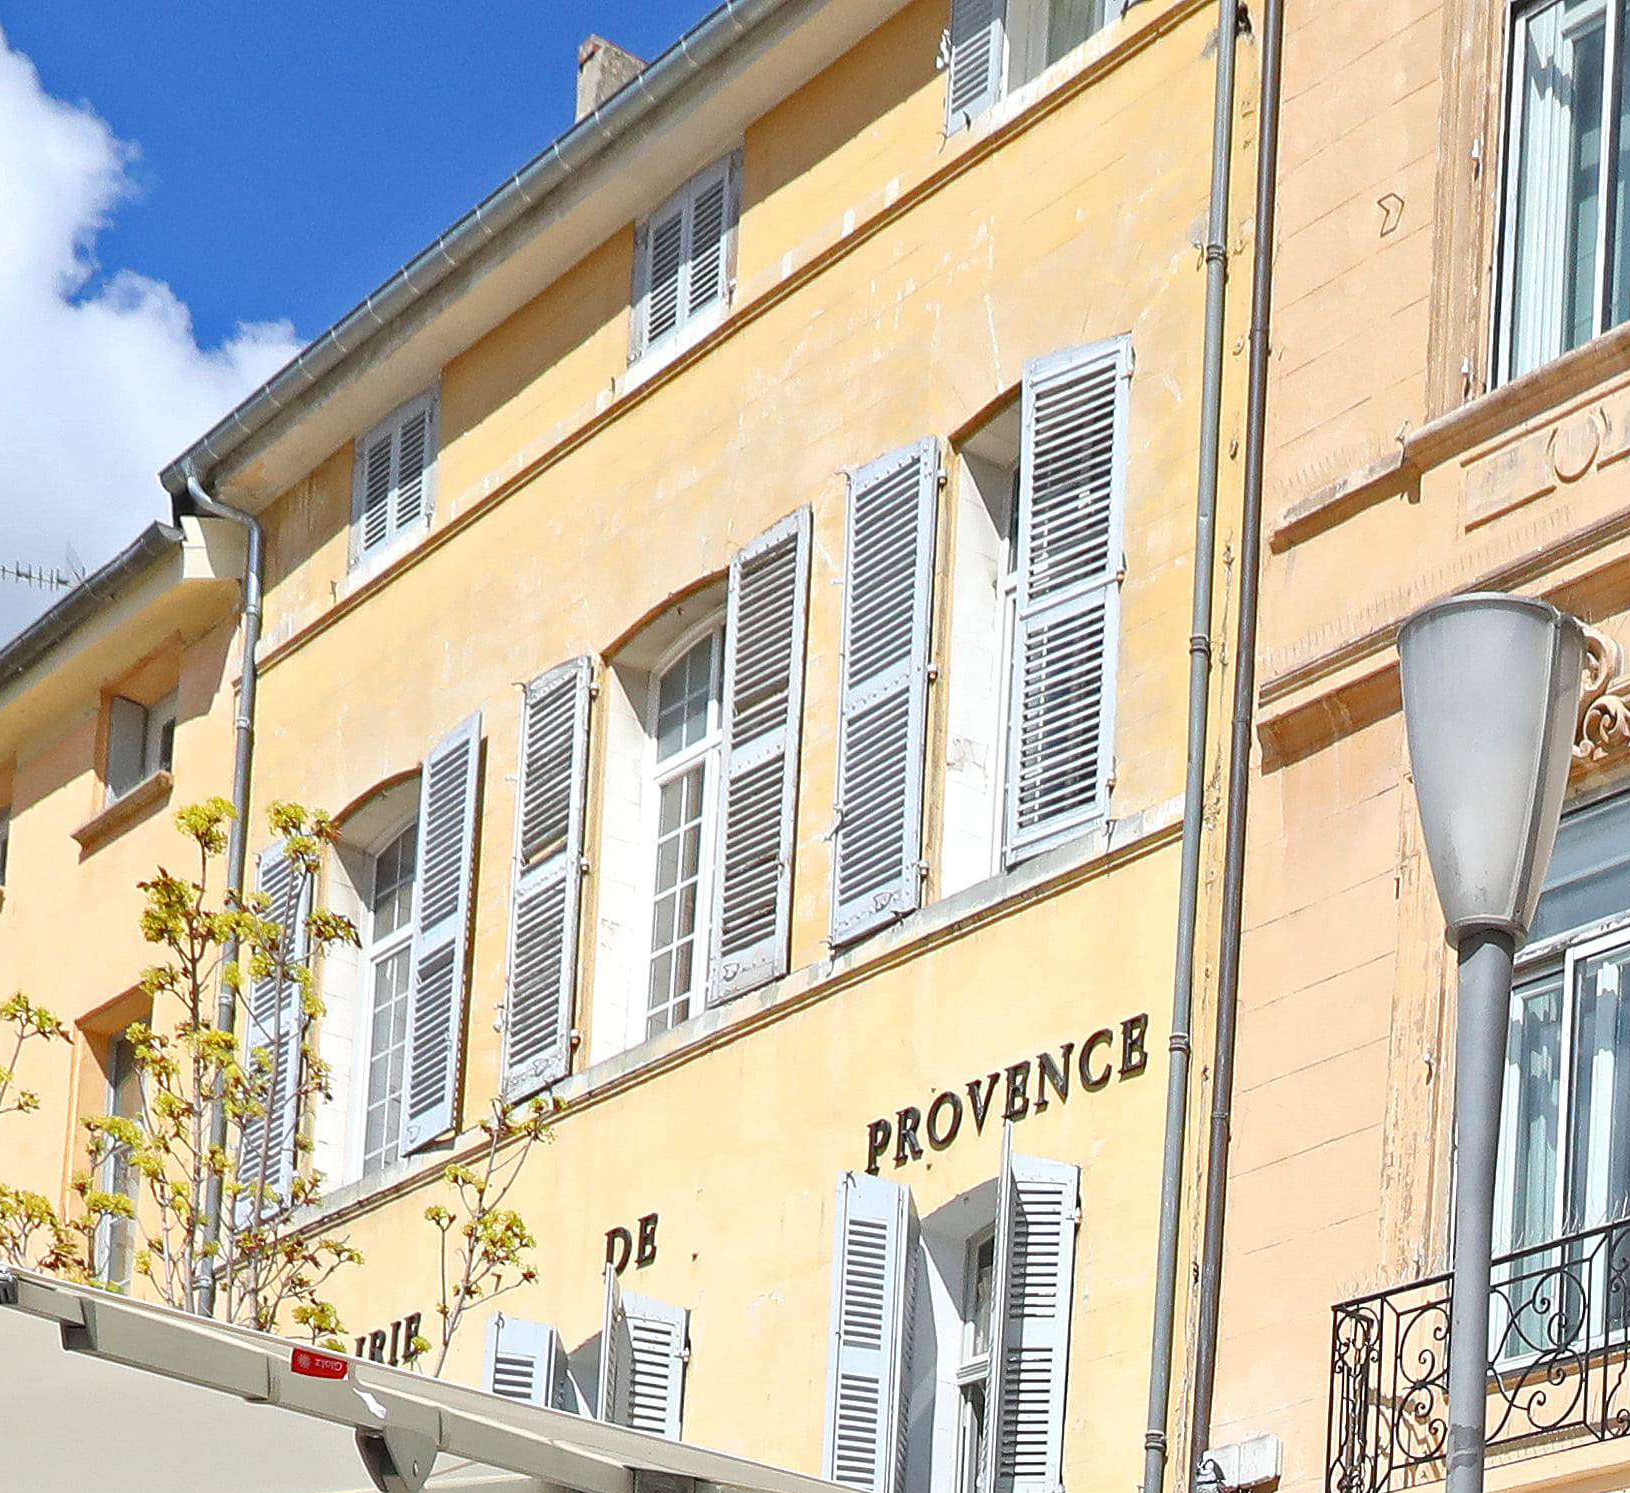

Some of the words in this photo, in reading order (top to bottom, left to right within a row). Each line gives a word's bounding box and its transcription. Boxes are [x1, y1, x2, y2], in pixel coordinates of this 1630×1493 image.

[354, 1311, 422, 1368] IRIE
[604, 1212, 659, 1276] DE
[864, 1012, 1150, 1176] PROVENCE
